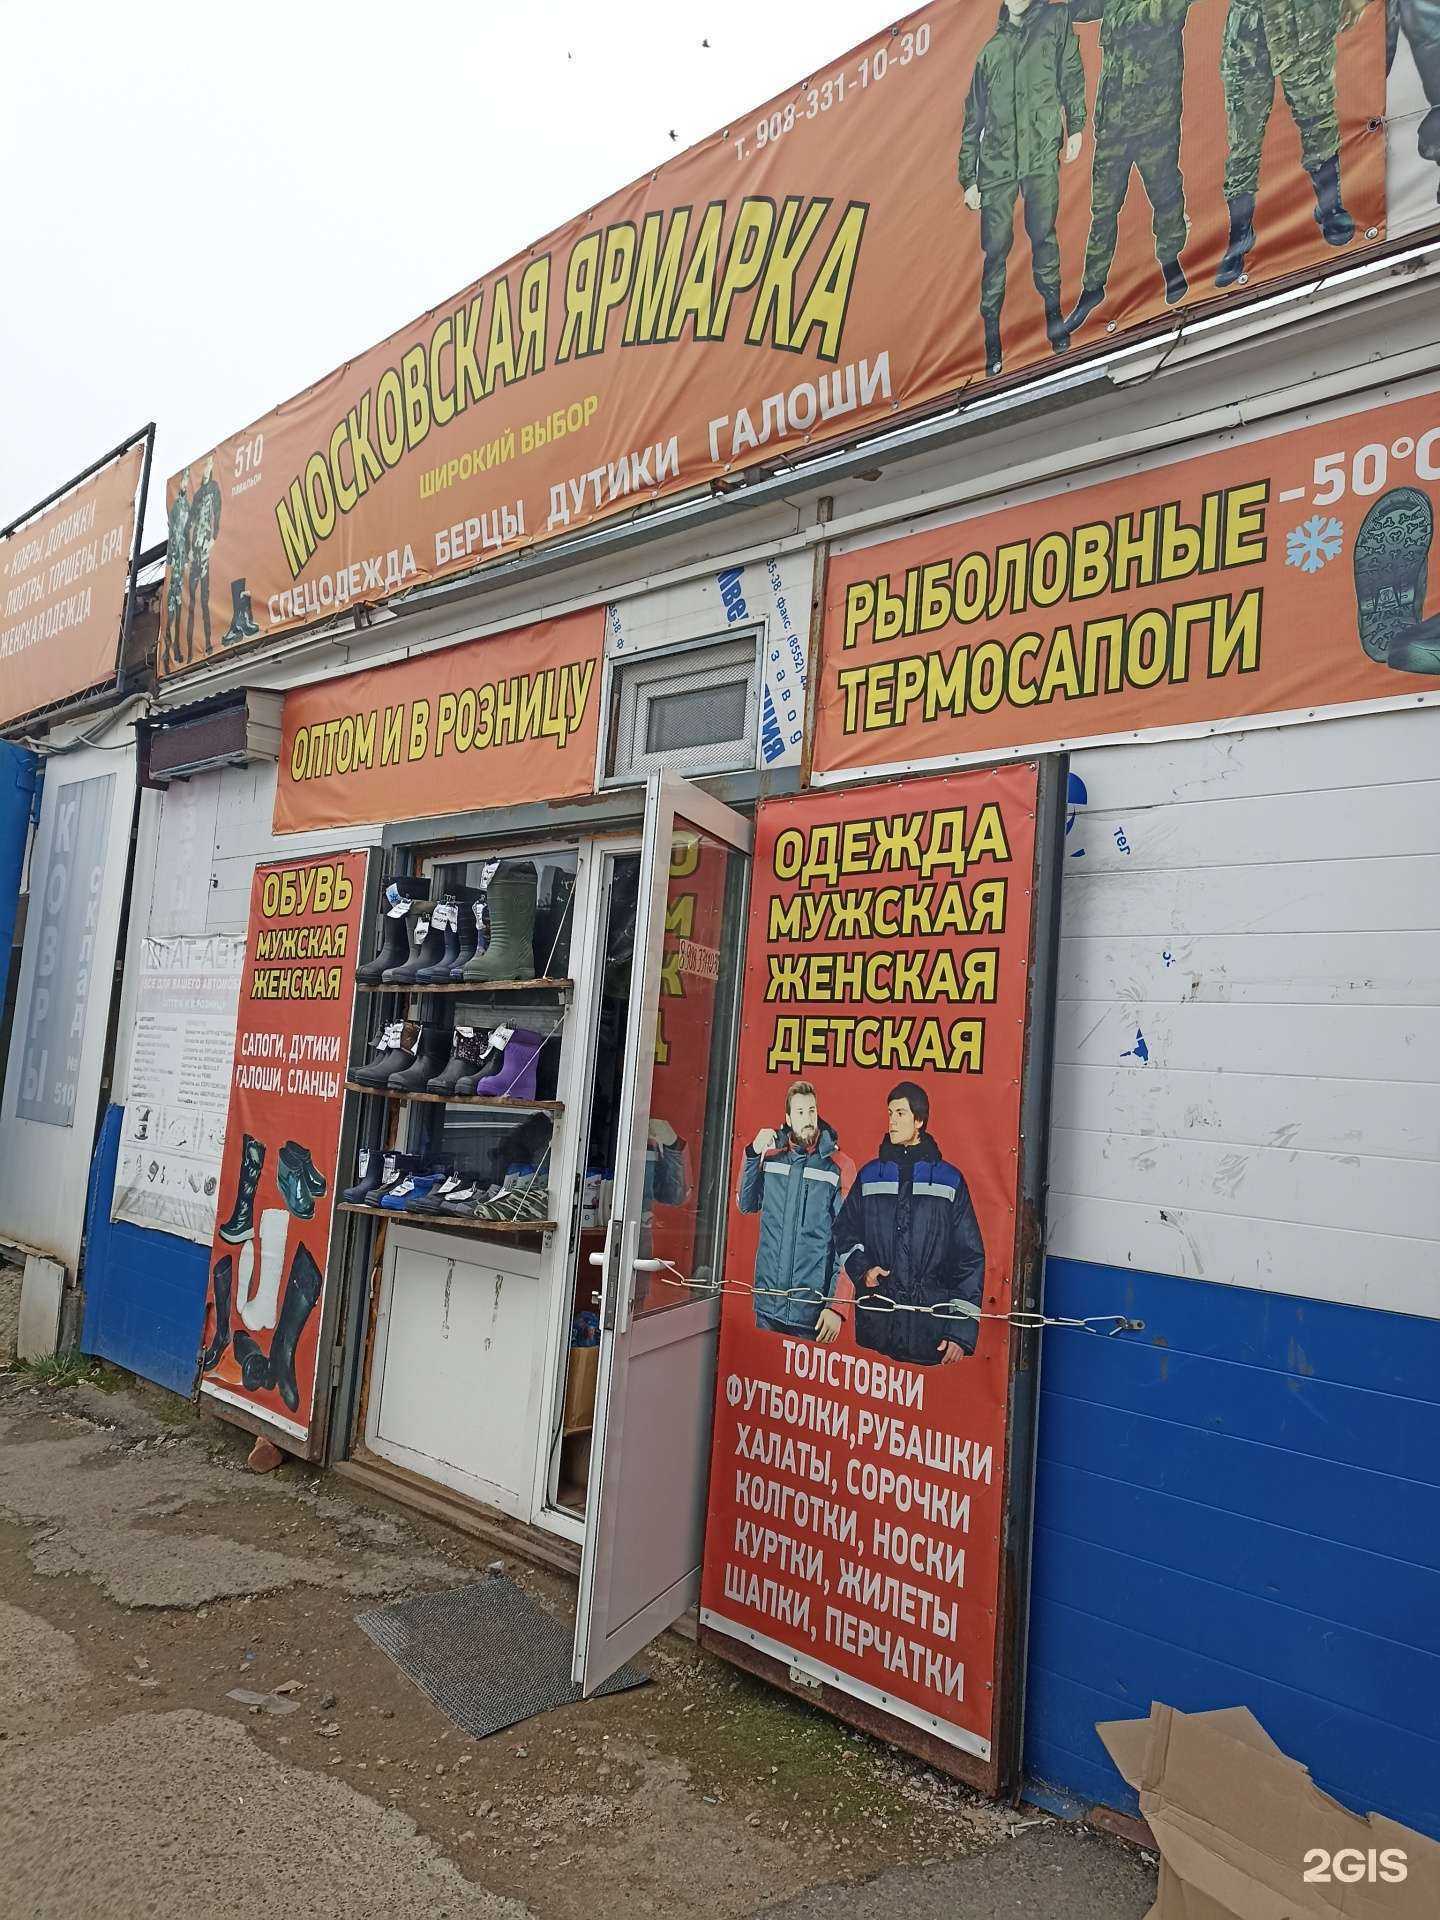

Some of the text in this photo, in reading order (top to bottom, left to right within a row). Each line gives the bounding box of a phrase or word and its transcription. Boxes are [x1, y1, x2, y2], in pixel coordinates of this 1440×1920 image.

[756, 23, 931, 149] 908-331-10-30
[275, 194, 871, 578] МОСКОВСКАЯ ЯРМАРКА
[235, 433, 263, 478] 510
[418, 395, 599, 498] ШИРОКИЙ ВЫБОР
[268, 350, 892, 624] СПЕЦОДЕЖДА БЕРЦЫ ДУТИКИ ГАЛОШИ
[101, 525, 123, 565] БРА
[842, 478, 1270, 650] РЫБОЛОВНЫЕ
[45, 586, 92, 639] ОДЕЖДА
[838, 587, 1264, 736] ТЕРМОСАПОГИ
[291, 658, 597, 782] ОПТОМ И В РОЗНИЦУ
[772, 802, 1013, 890] ОДЕЖДА
[261, 862, 353, 918] ОБУВЬ
[767, 877, 1008, 943] МУЖСКАЯ
[250, 965, 342, 1000] ЖЕНСКАЯ
[255, 924, 348, 961] МУЖСКАЯ
[763, 947, 1000, 1003] ЖЕНСКАЯ
[236, 1065, 340, 1102] ГАЛОШИ, СЛАНЦЫ
[241, 1032, 341, 1066] САПОГИ, ДУТИКИ
[766, 1014, 986, 1075] ДЕТСКАЯ
[783, 1339, 924, 1411] ТОЛСТОВКИ
[735, 1423, 970, 1533] ХАЛАТЫ, СОРОЧКИ
[735, 1470, 966, 1589] КОЛГОТКИ, НОСКИ
[734, 1518, 958, 1642] КУРТКИ, ЖИЛЕТЫ
[723, 1563, 964, 1702] ШАПКИ, ПЕРЧАТКИ
